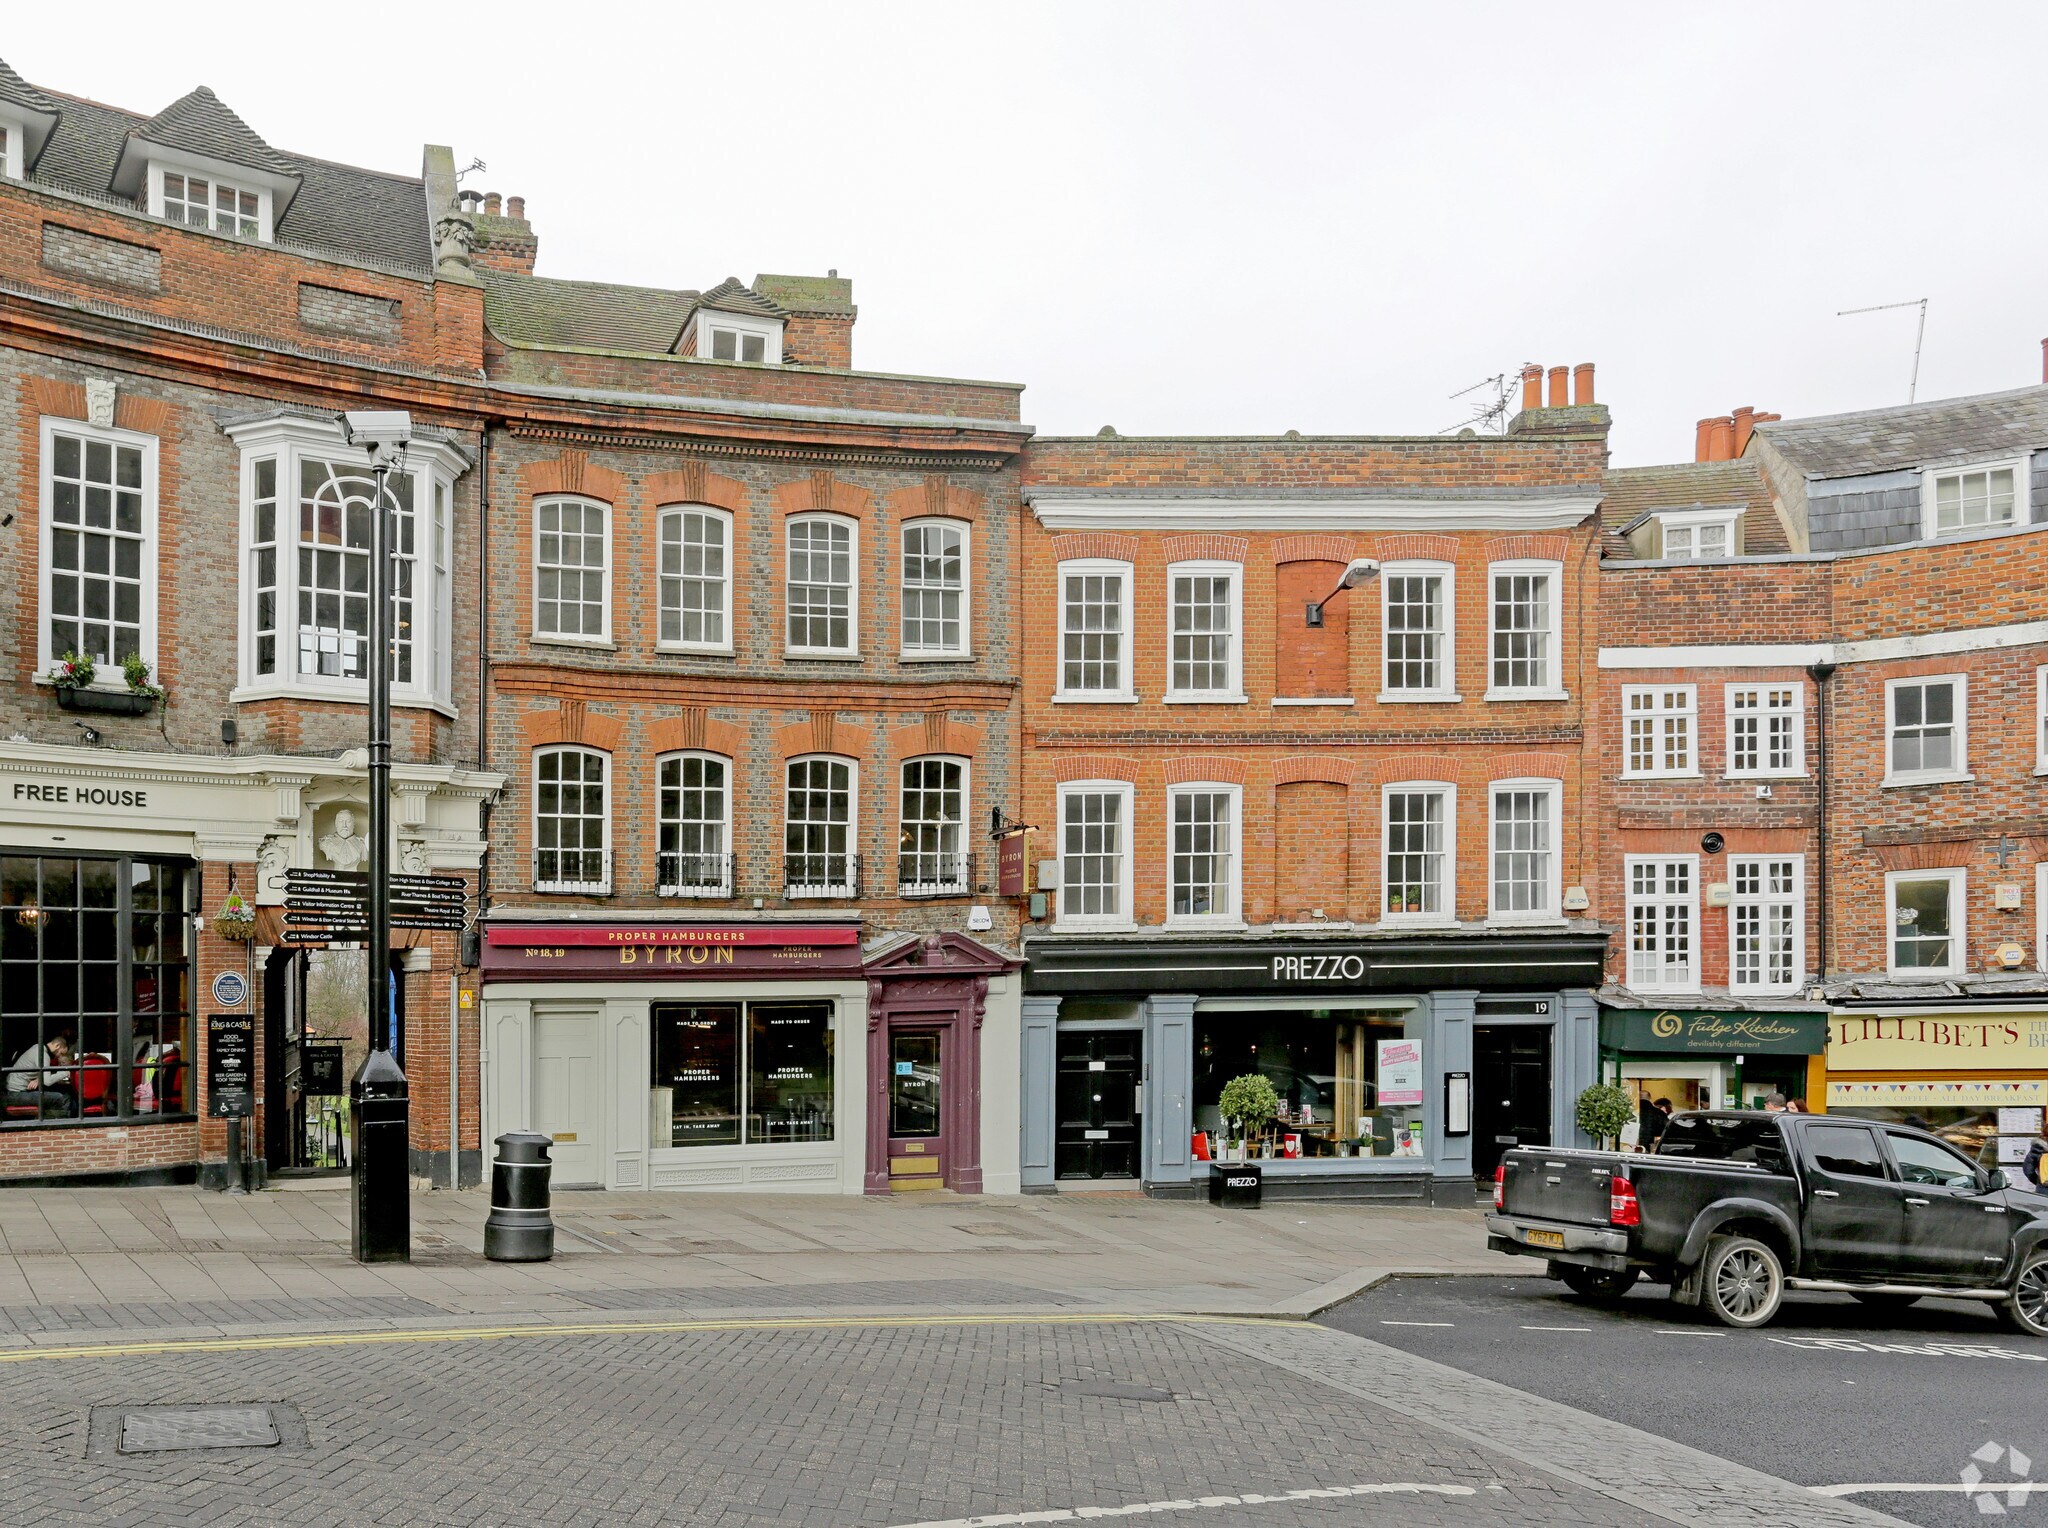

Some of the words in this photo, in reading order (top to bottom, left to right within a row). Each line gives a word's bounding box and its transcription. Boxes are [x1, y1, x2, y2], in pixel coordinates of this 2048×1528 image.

[13, 784, 68, 802] FREE
[76, 787, 147, 807] HOUSE
[1001, 852, 1022, 863] BYRON
[608, 932, 656, 941] PROPER
[662, 932, 745, 941] HAMBURGERS
[555, 949, 565, 958] 19
[620, 945, 733, 964] BYRON
[1273, 955, 1364, 980] PREZZO
[1535, 1002, 1547, 1013] 19
[1688, 1015, 1731, 1038] Fudge
[1732, 1017, 1800, 1042] Kitchen
[1840, 1017, 2019, 1048] LILLIBET'S
[1687, 1040, 1725, 1049] devilishly
[1726, 1040, 1761, 1048] different
[1227, 1177, 1258, 1187] PREZZO
